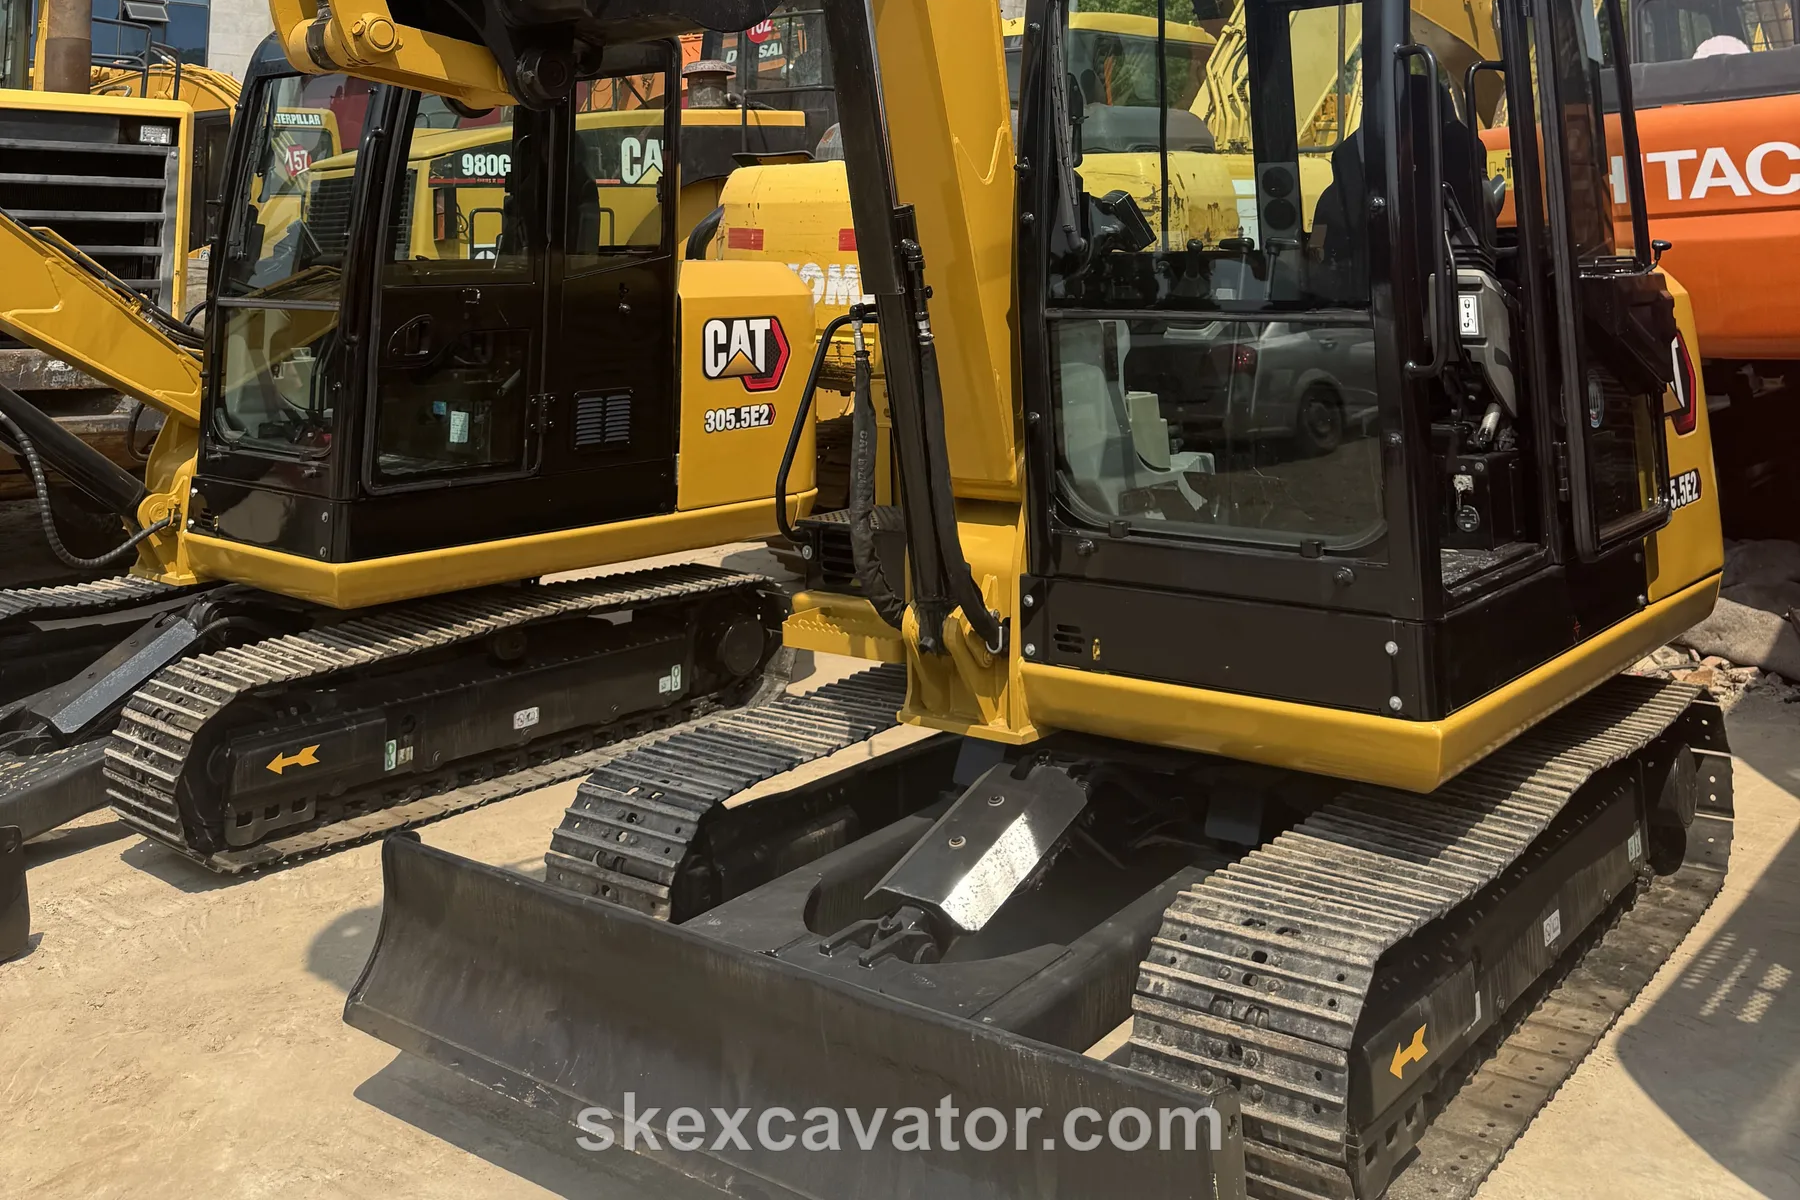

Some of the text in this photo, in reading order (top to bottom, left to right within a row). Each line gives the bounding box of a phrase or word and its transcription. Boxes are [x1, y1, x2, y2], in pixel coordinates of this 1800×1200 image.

[276, 113, 321, 125] TERPILLAR
[285, 150, 308, 172] 157
[462, 153, 511, 177] 980G
[621, 137, 664, 184] CA
[704, 318, 771, 378] CAT
[705, 403, 770, 433] 305.5E2
[1670, 470, 1699, 509] 5.5E2
